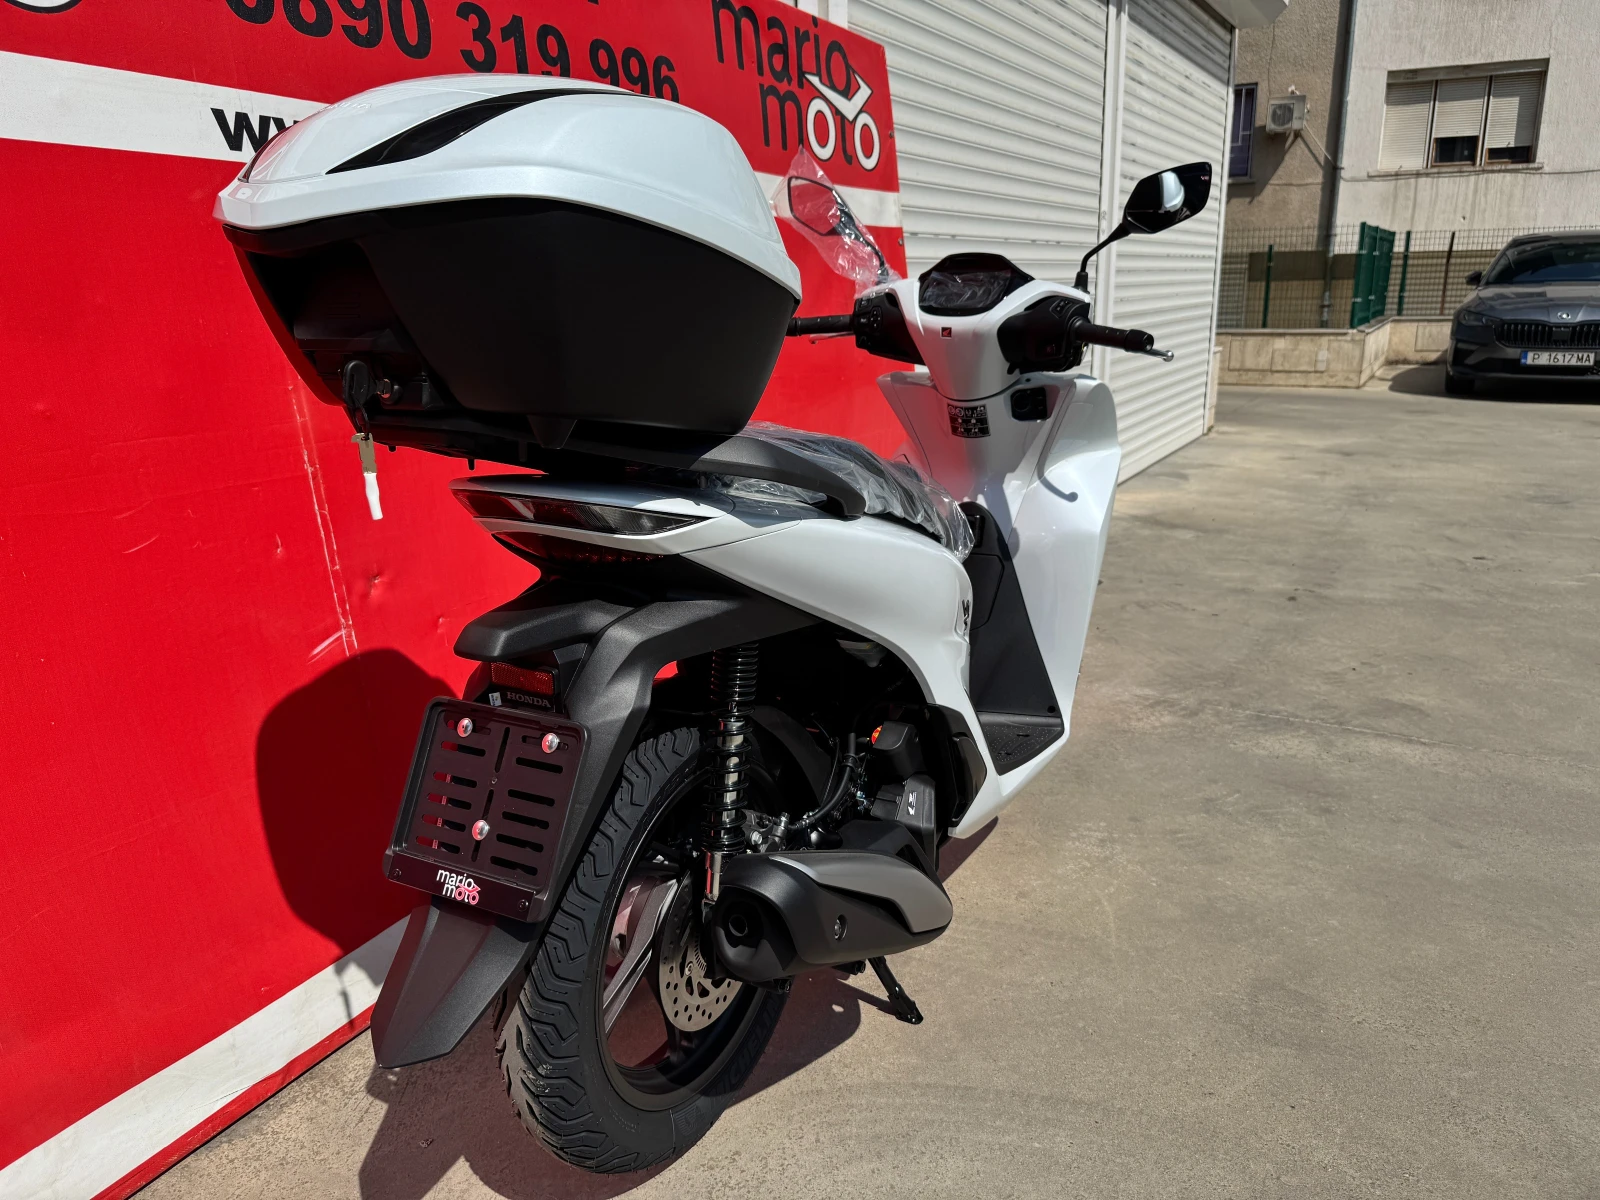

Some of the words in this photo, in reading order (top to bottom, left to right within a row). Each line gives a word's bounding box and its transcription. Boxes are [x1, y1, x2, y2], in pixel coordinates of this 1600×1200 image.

[225, 0, 433, 60] 90
[455, 1, 571, 77] 319
[588, 38, 680, 104] 996
[711, 0, 853, 98] mario
[758, 82, 881, 172] moto
[506, 691, 551, 708] HONDA
[436, 869, 475, 890] mario
[442, 883, 480, 905] moto
